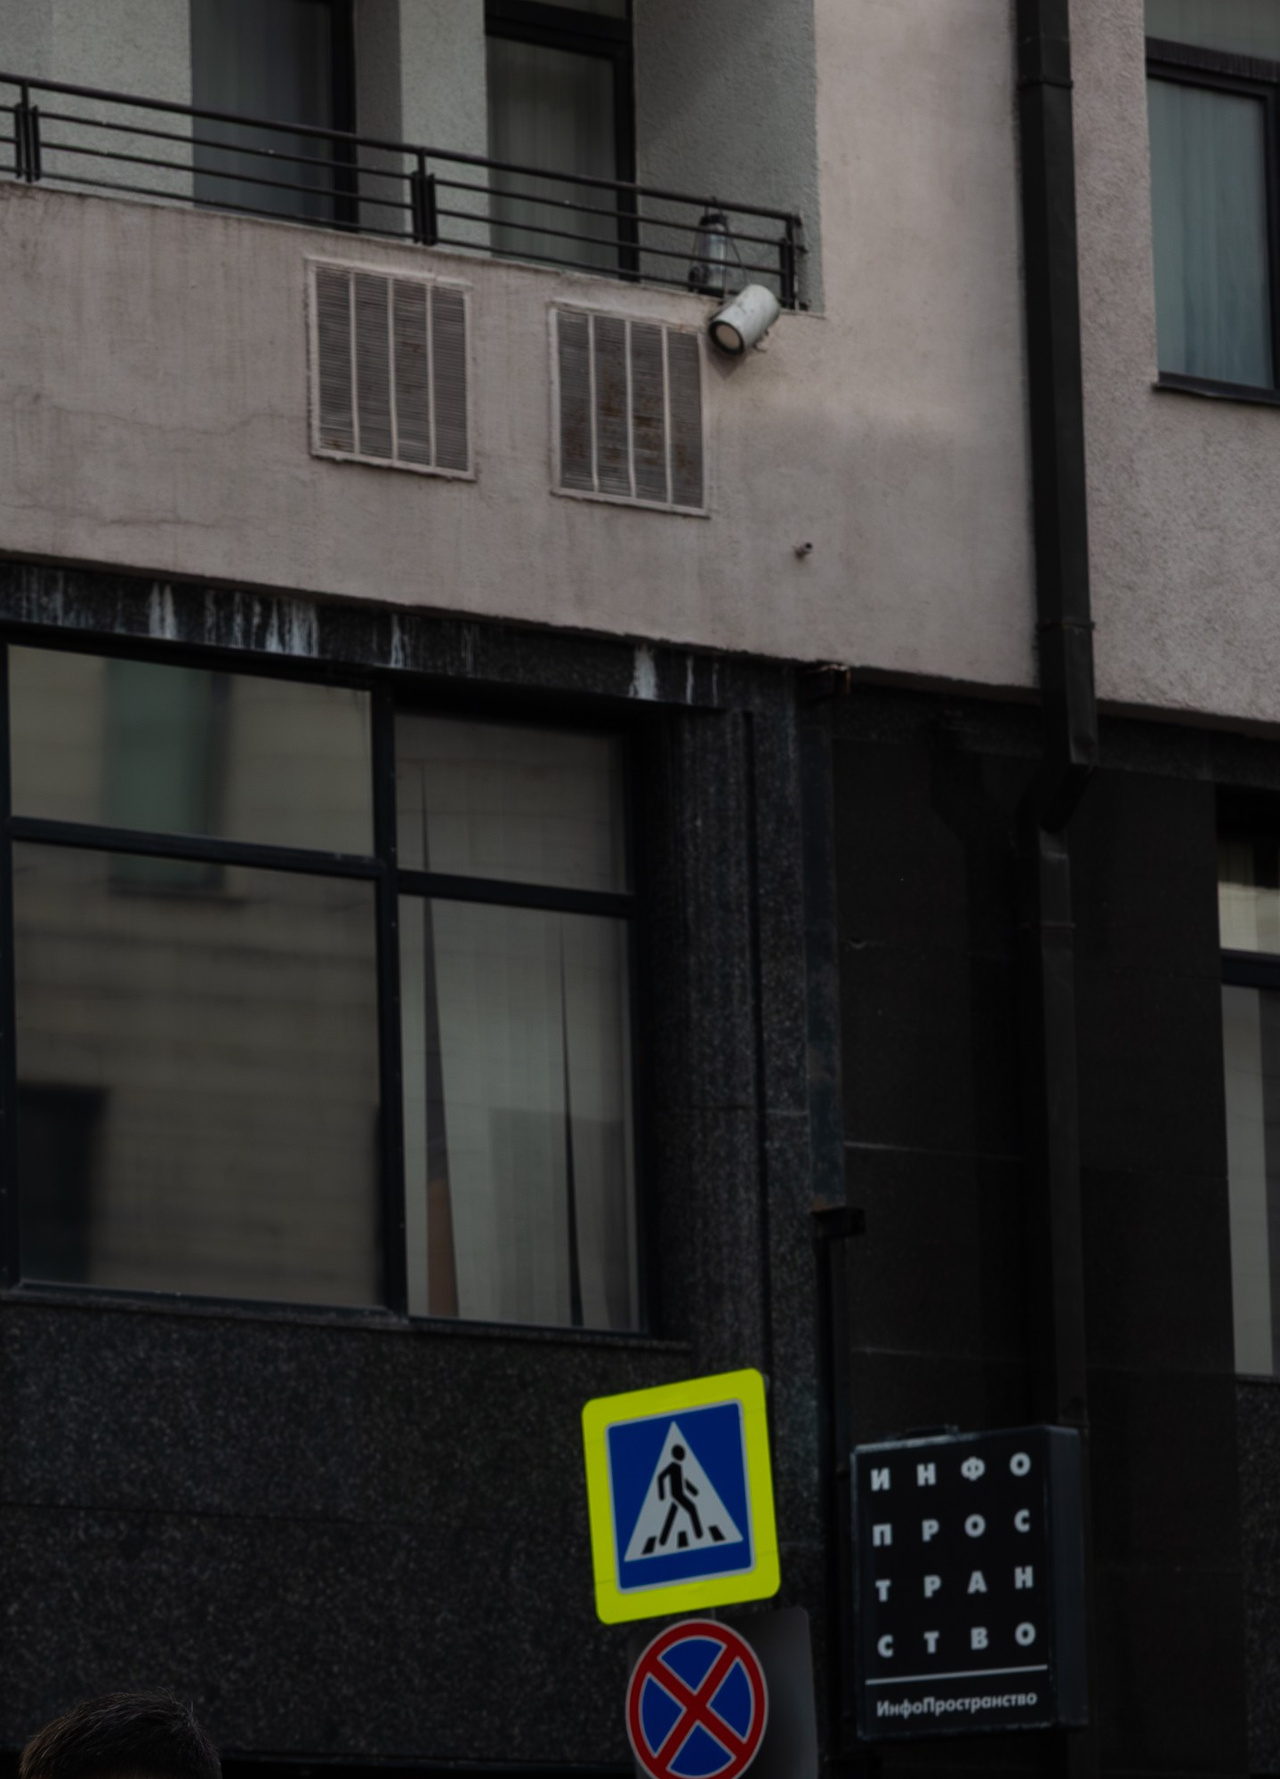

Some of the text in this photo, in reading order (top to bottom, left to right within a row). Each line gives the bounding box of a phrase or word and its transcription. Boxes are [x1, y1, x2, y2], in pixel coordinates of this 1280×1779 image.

[870, 1452, 1031, 1492] ИНФО
[872, 1509, 1031, 1547] ПРОС
[874, 1565, 1034, 1602] ТРАН
[877, 1622, 1036, 1658] СТВО
[876, 1692, 1038, 1720] ИнфоПространство
